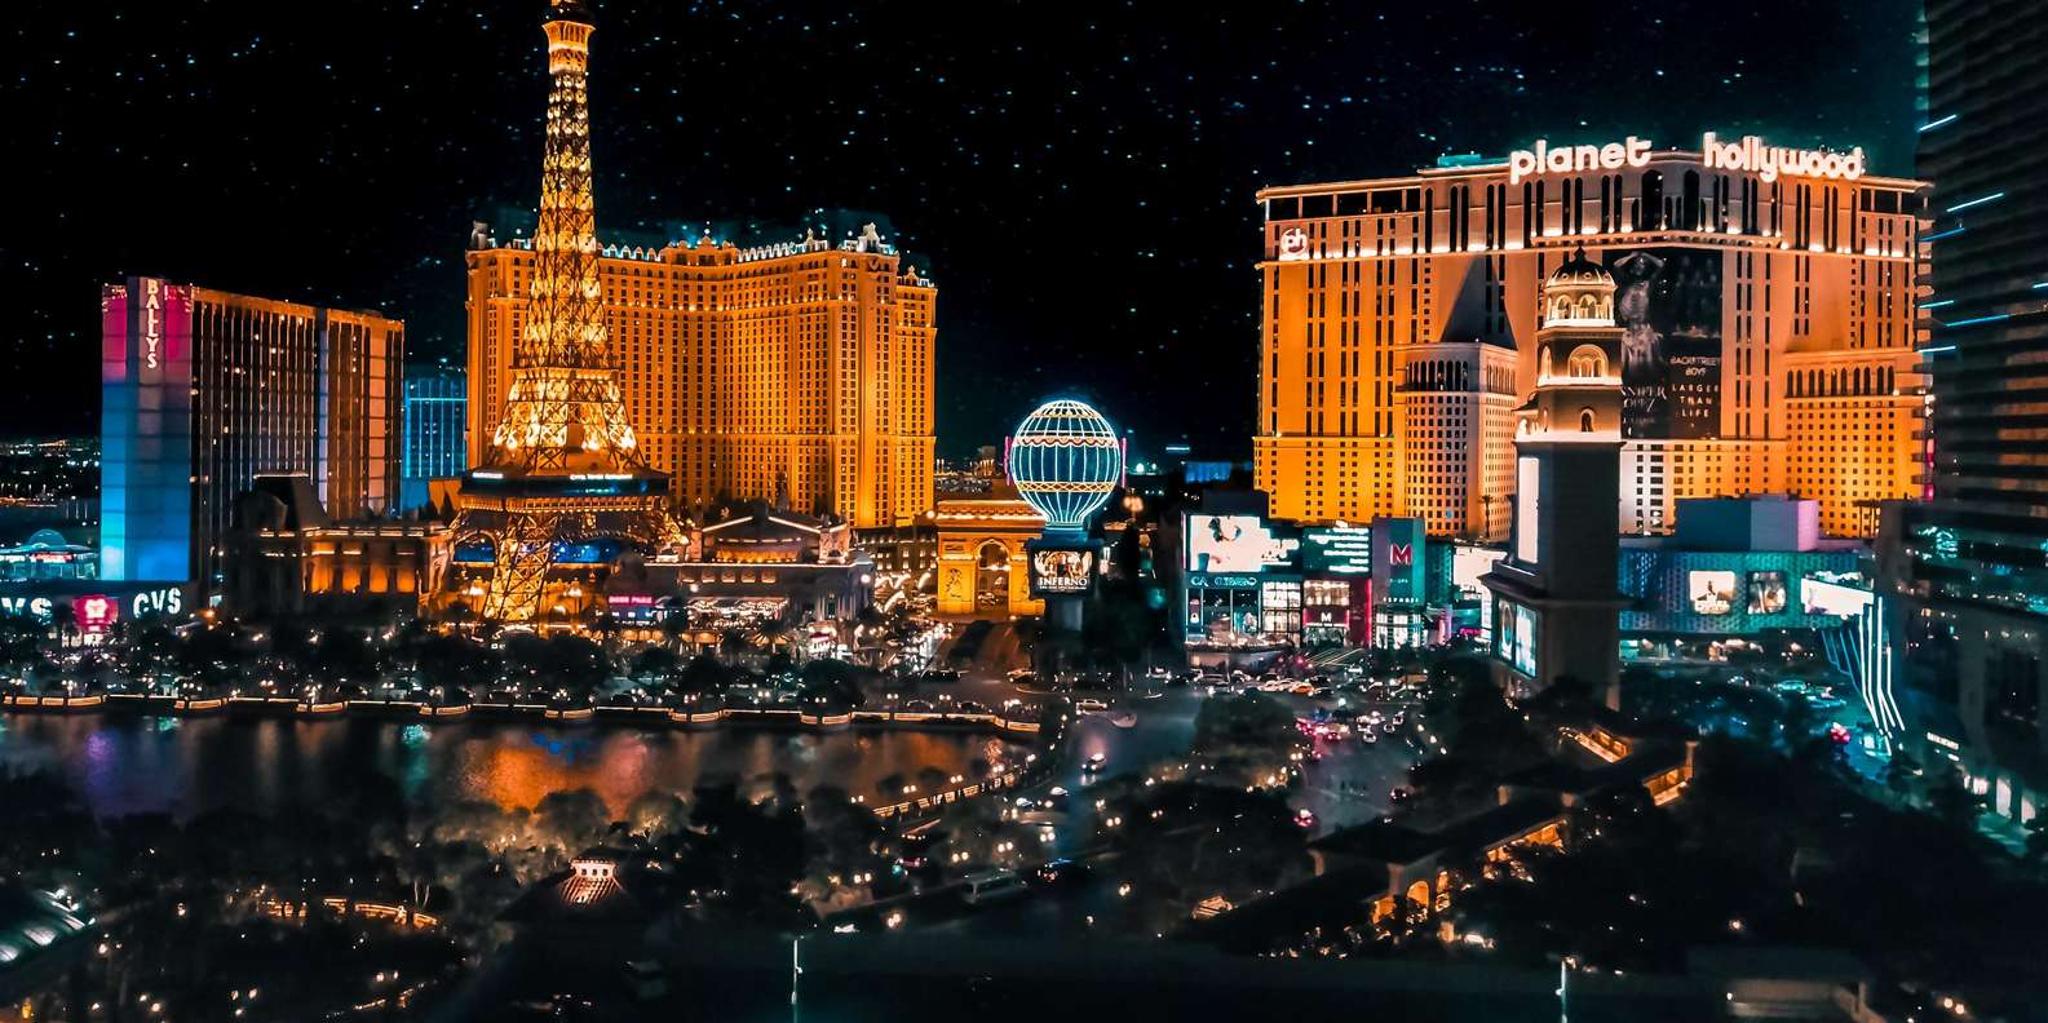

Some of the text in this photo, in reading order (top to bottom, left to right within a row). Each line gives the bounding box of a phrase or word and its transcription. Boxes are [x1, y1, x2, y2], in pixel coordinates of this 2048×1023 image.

[1510, 131, 1864, 185] planet hollywood
[1672, 383, 1719, 393] LARGER
[1680, 395, 1713, 406] THAN
[1681, 408, 1710, 418] LIFE
[1389, 543, 1413, 565] M
[1039, 576, 1087, 586] INFERNO
[133, 587, 182, 618] CVS
[1320, 611, 1333, 622] M
